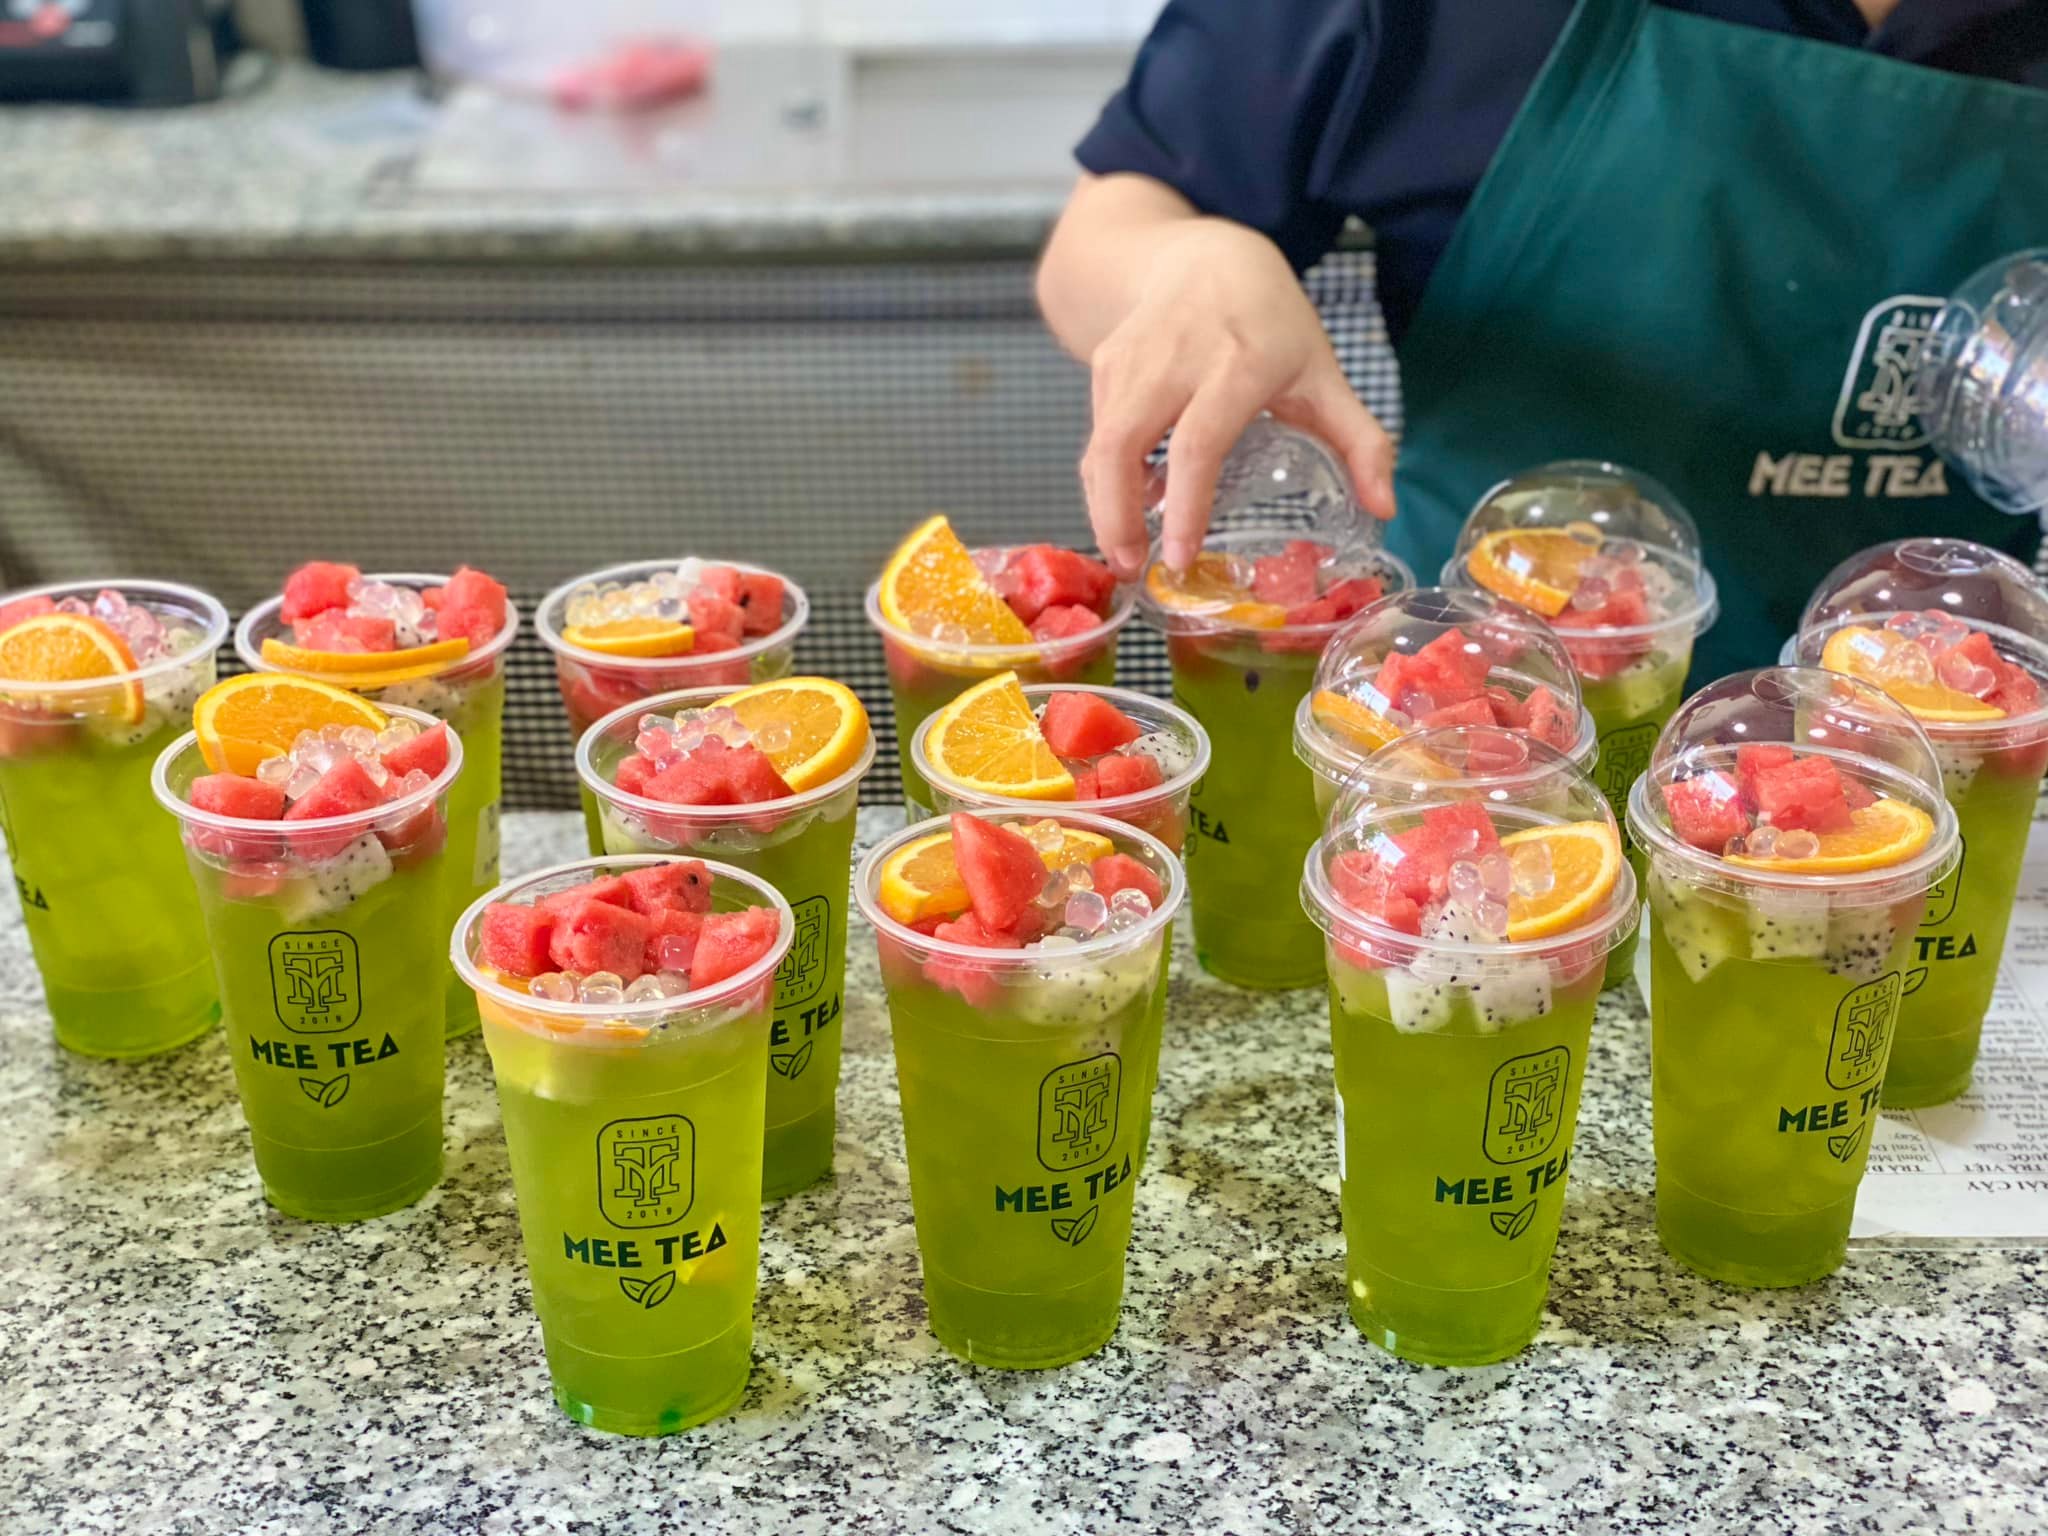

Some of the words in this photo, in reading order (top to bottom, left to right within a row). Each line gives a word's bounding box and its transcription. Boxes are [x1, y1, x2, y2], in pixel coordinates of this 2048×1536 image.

[1748, 451, 1852, 497] MEE
[1864, 455, 1948, 497] TEA
[284, 939, 340, 950] SINCE
[1914, 933, 1977, 961] TEA
[800, 992, 840, 1035] TEA
[250, 1033, 318, 1069] MEE
[328, 1032, 399, 1068] TEA
[1510, 1056, 1560, 1076] SINCE
[1059, 1063, 1109, 1083] SINCE
[1778, 1100, 1848, 1132] MEE
[1860, 1080, 1881, 1117] TE
[617, 1125, 677, 1138] SINCE
[995, 1183, 1073, 1213] MEE
[1085, 1152, 1131, 1200] TEA
[1435, 1175, 1513, 1205] MEE
[1527, 1147, 1568, 1195] TEA
[564, 1232, 642, 1268] MEE
[655, 1222, 728, 1265] TEA
